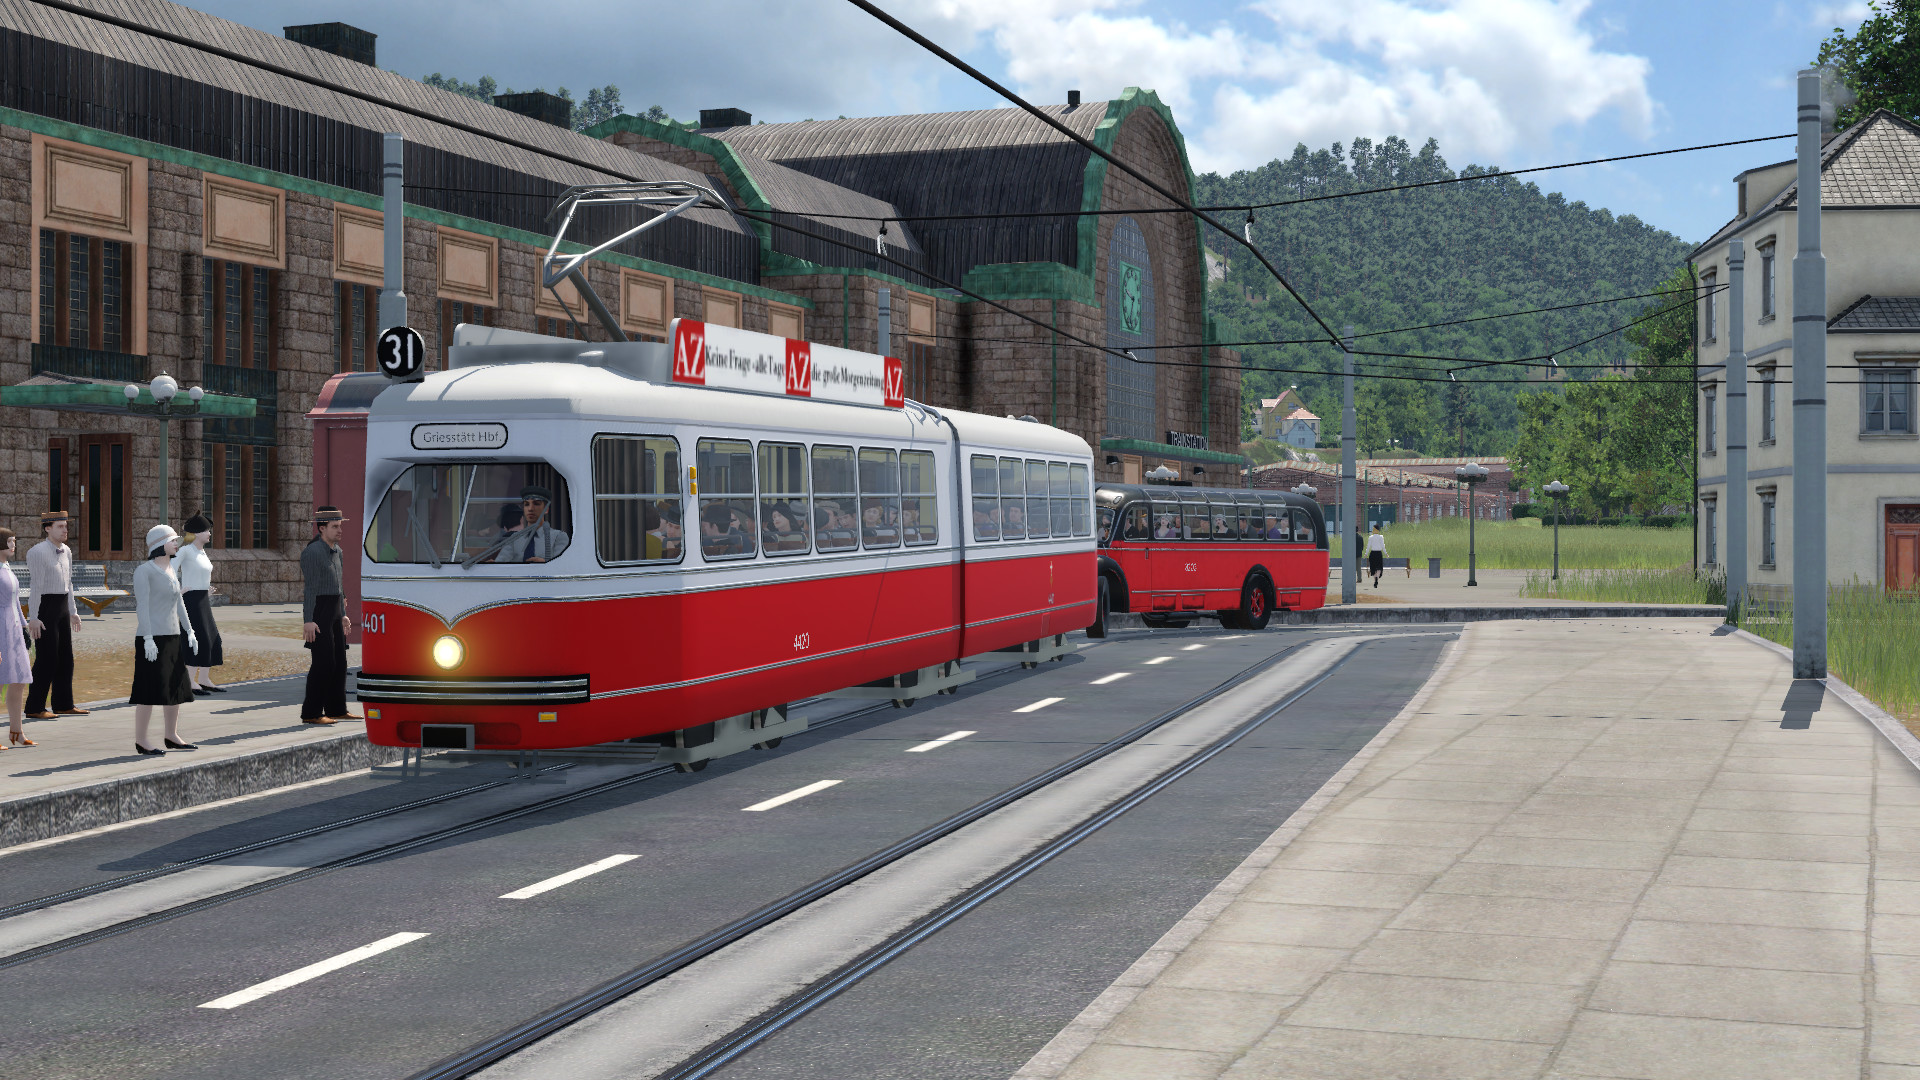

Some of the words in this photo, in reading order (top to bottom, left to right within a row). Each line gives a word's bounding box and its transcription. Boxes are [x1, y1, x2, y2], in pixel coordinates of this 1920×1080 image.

[385, 333, 414, 369] 31
[674, 331, 705, 379] AZ
[705, 345, 728, 370] Keine
[729, 348, 751, 377] Frage
[786, 352, 811, 393] AZ
[812, 362, 821, 382] die
[840, 366, 885, 394] Morgenzeitung
[885, 366, 903, 401] AZ
[423, 431, 476, 444] Griesstätt
[478, 431, 502, 443] Hbf.
